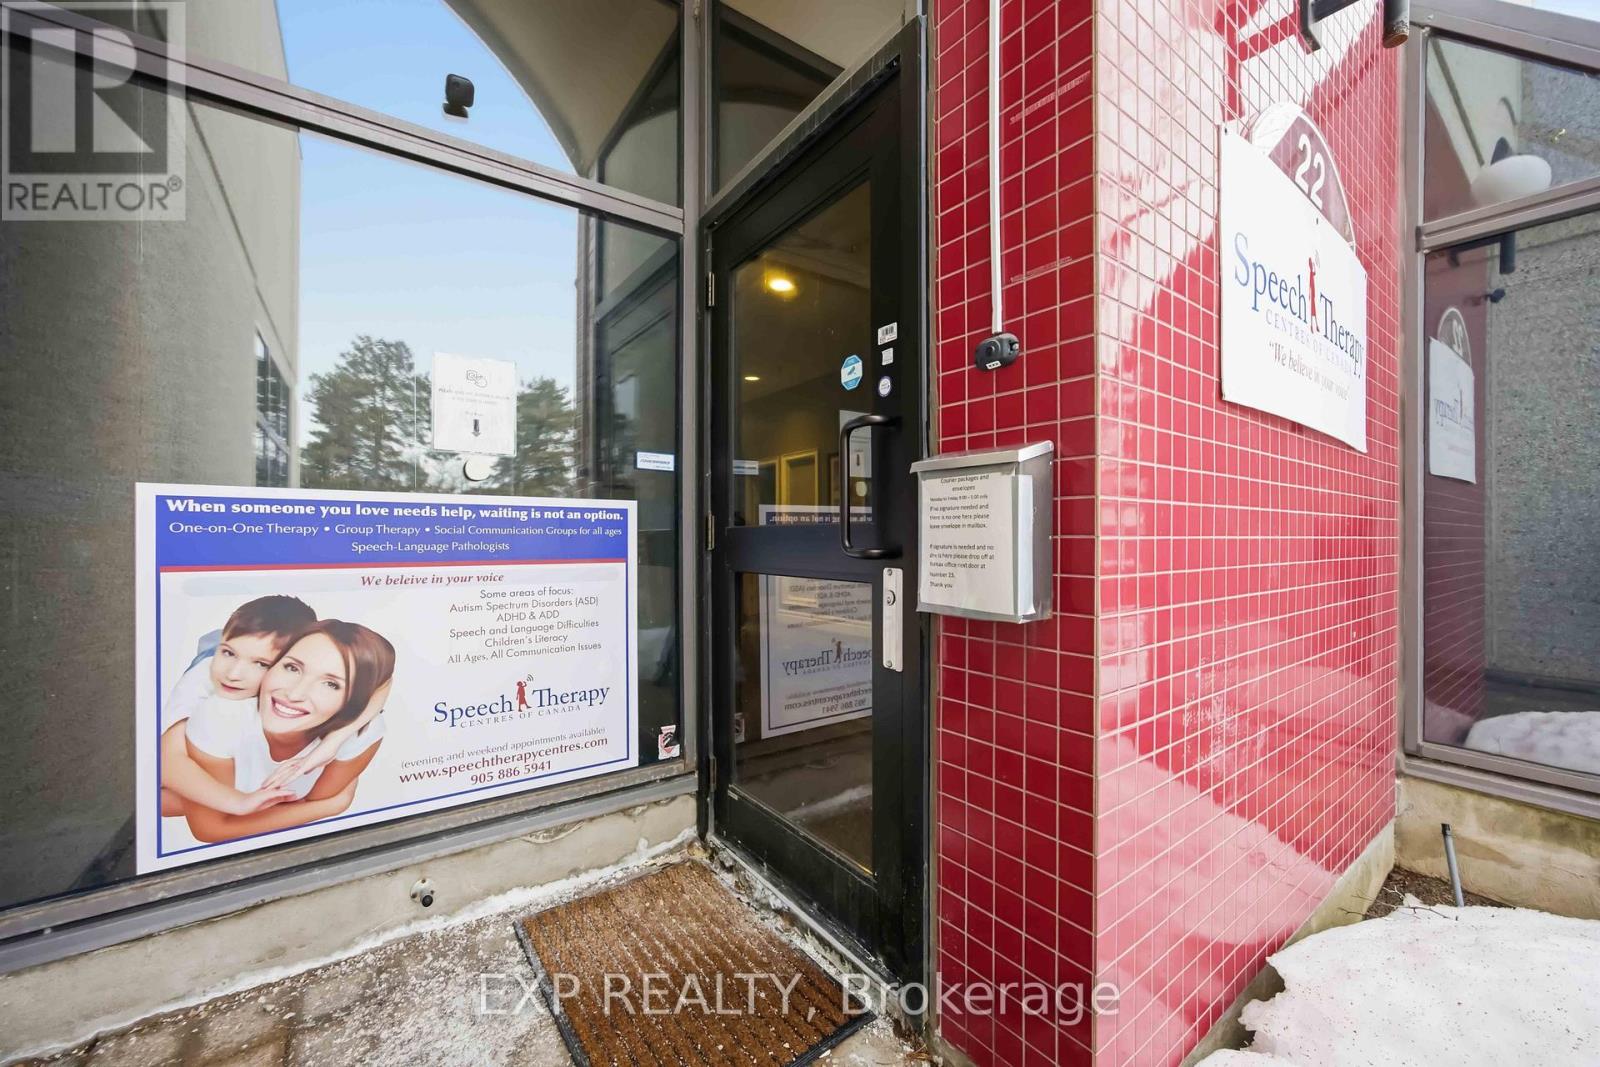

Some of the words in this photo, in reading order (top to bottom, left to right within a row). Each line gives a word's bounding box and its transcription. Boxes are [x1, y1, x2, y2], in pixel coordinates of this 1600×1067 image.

[1295, 133, 1325, 210] 22
[1234, 232, 1308, 325] Speech
[1320, 292, 1364, 378] Therapy
[1265, 308, 1310, 347] CENTRES
[1289, 349, 1312, 380] believe
[166, 499, 226, 512] When
[231, 503, 316, 515] someone
[320, 505, 351, 518] you
[356, 504, 389, 516] love
[394, 505, 438, 517] needs
[441, 506, 476, 520] help,
[479, 508, 528, 522] waiting
[531, 508, 541, 519] is
[544, 509, 564, 519] not
[567, 511, 581, 519] an
[584, 509, 624, 523] option.
[169, 522, 264, 534] One-on-One
[266, 523, 319, 537] Therapy
[335, 524, 373, 537] Group
[376, 525, 421, 537] Therapy
[434, 525, 465, 535] Social
[468, 526, 544, 535] Communication
[546, 526, 577, 537] Groups
[579, 526, 590, 535] for
[592, 527, 602, 535] all
[604, 528, 622, 538] ages
[351, 541, 449, 554] Speech-Language
[451, 542, 510, 552] Pathologists
[361, 576, 382, 586] We
[385, 574, 428, 585] beleive
[431, 575, 443, 584] in
[445, 574, 473, 586] your
[475, 573, 504, 583] voice
[450, 604, 483, 613] Autism
[486, 601, 529, 613] Spectrum
[532, 598, 572, 608] Disorders
[575, 596, 599, 607] (ASD)
[480, 590, 506, 599] Some
[509, 589, 535, 597] areas
[538, 588, 546, 596] of
[548, 587, 574, 596] focus:
[496, 612, 526, 622] ADHD
[528, 612, 537, 621] &
[539, 610, 560, 619] ADD
[450, 626, 486, 640] Speech
[489, 626, 508, 636] and
[511, 622, 554, 635] Language
[557, 619, 599, 630] Difficulties
[484, 636, 533, 648] Children's
[535, 634, 568, 645] Literacy
[447, 653, 461, 664] All
[463, 654, 489, 664] Ages,
[490, 649, 503, 660] All
[506, 643, 576, 658] Communication
[578, 642, 602, 651] Issues
[434, 694, 513, 727] Speech
[532, 686, 610, 708] Therapy
[460, 714, 514, 728] CENTRES
[519, 711, 533, 719] OF
[538, 705, 582, 716] CANADA
[401, 754, 444, 769] (evening
[446, 749, 465, 760] and
[467, 743, 509, 757] weekend
[510, 734, 567, 750] appointments
[568, 727, 606, 740] available)
[399, 737, 608, 784] www.speechtherapycentres.com
[470, 772, 494, 785] 905
[498, 768, 520, 780] 886
[523, 760, 552, 775] 5941
